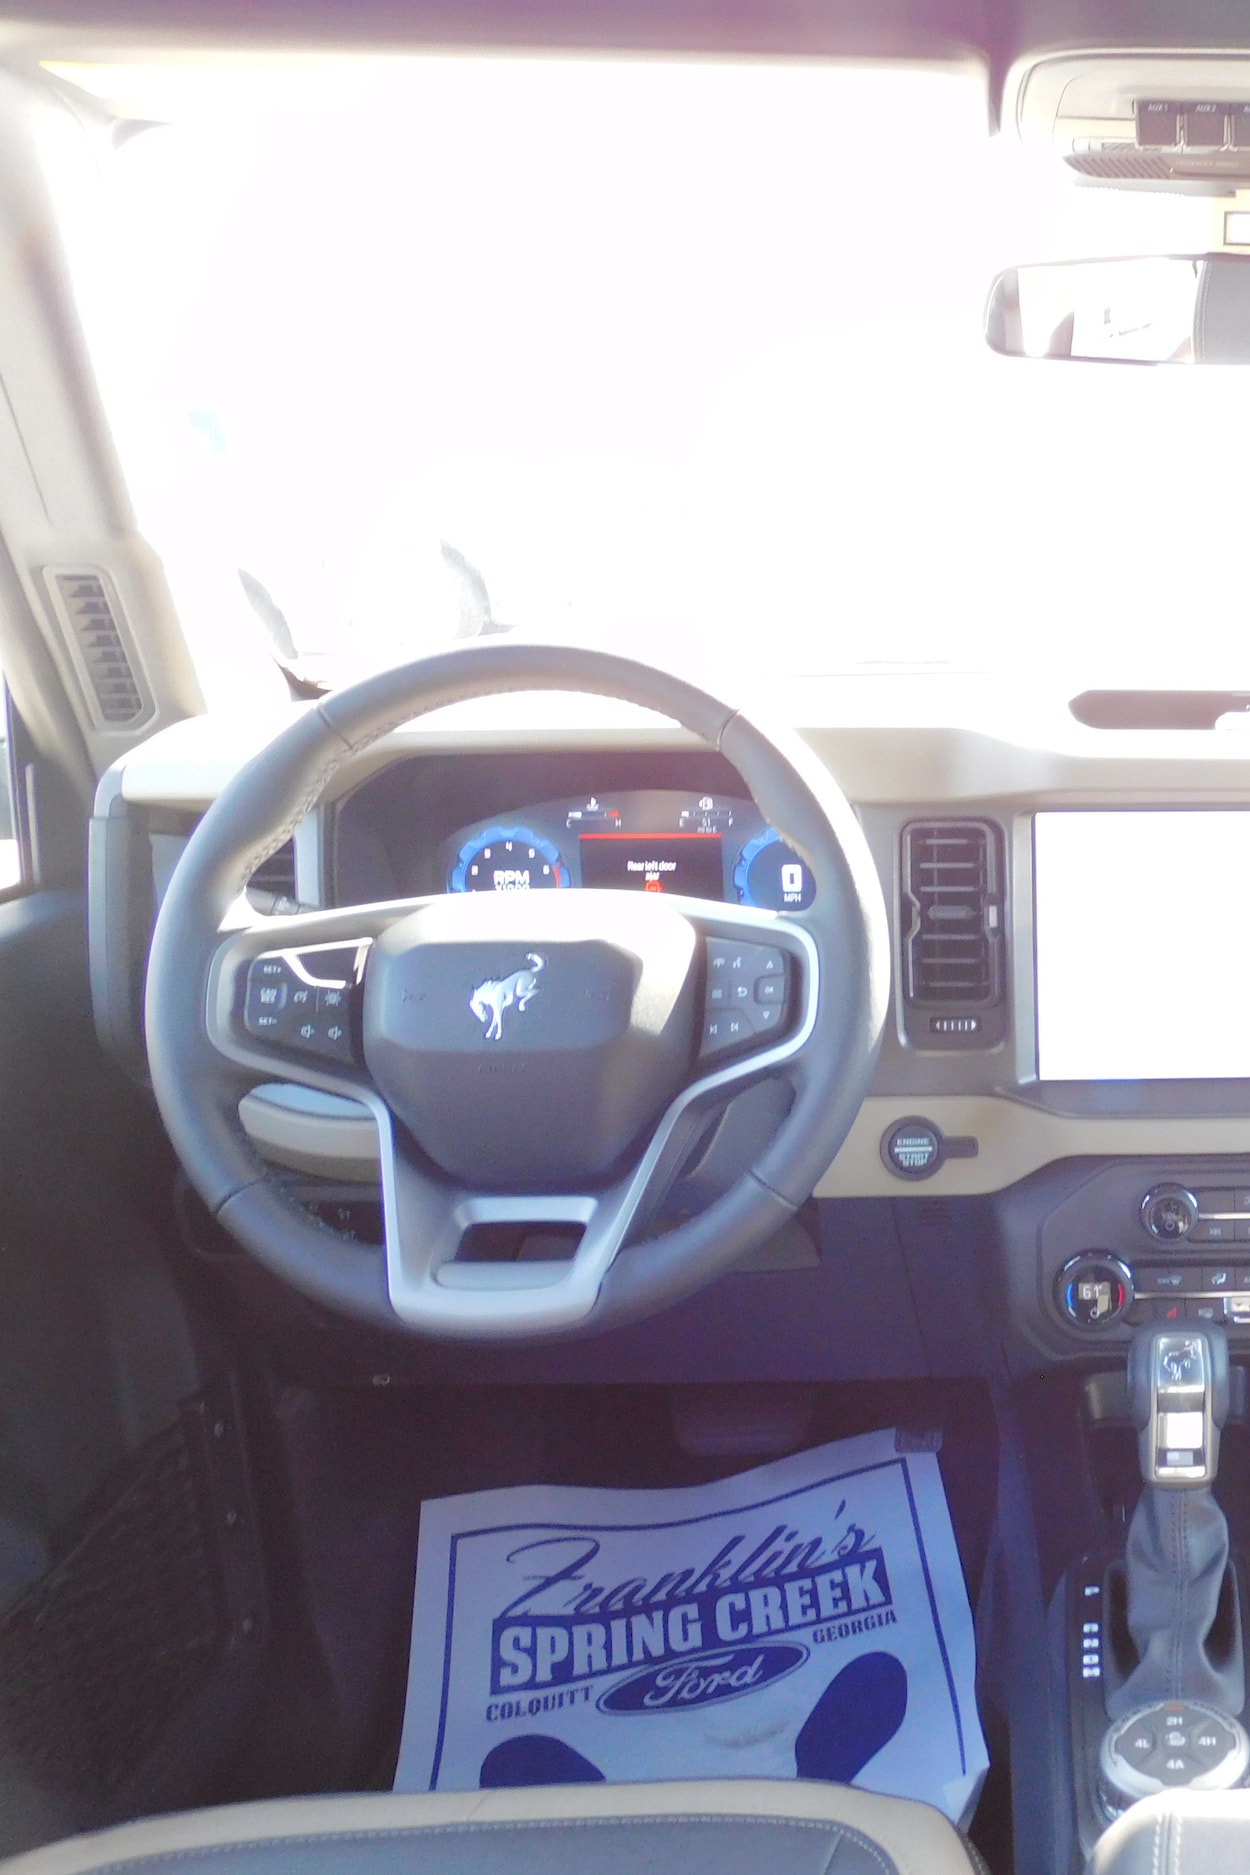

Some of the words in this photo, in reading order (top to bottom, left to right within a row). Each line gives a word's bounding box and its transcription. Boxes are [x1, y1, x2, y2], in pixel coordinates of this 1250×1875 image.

[493, 870, 530, 886] RPM
[781, 864, 802, 892] 0
[783, 893, 801, 903] MPH
[499, 1499, 878, 1619] Franklin's
[499, 1605, 703, 1688] SPRING
[714, 1559, 890, 1643] CREEK
[812, 1609, 898, 1644] GEORGIA
[643, 1648, 767, 1707] Ford
[485, 1684, 594, 1722] COLQUITT
[1135, 1738, 1150, 1748] 4L
[1198, 1736, 1216, 1746] 4H
[1166, 1759, 1184, 1769] 4A
